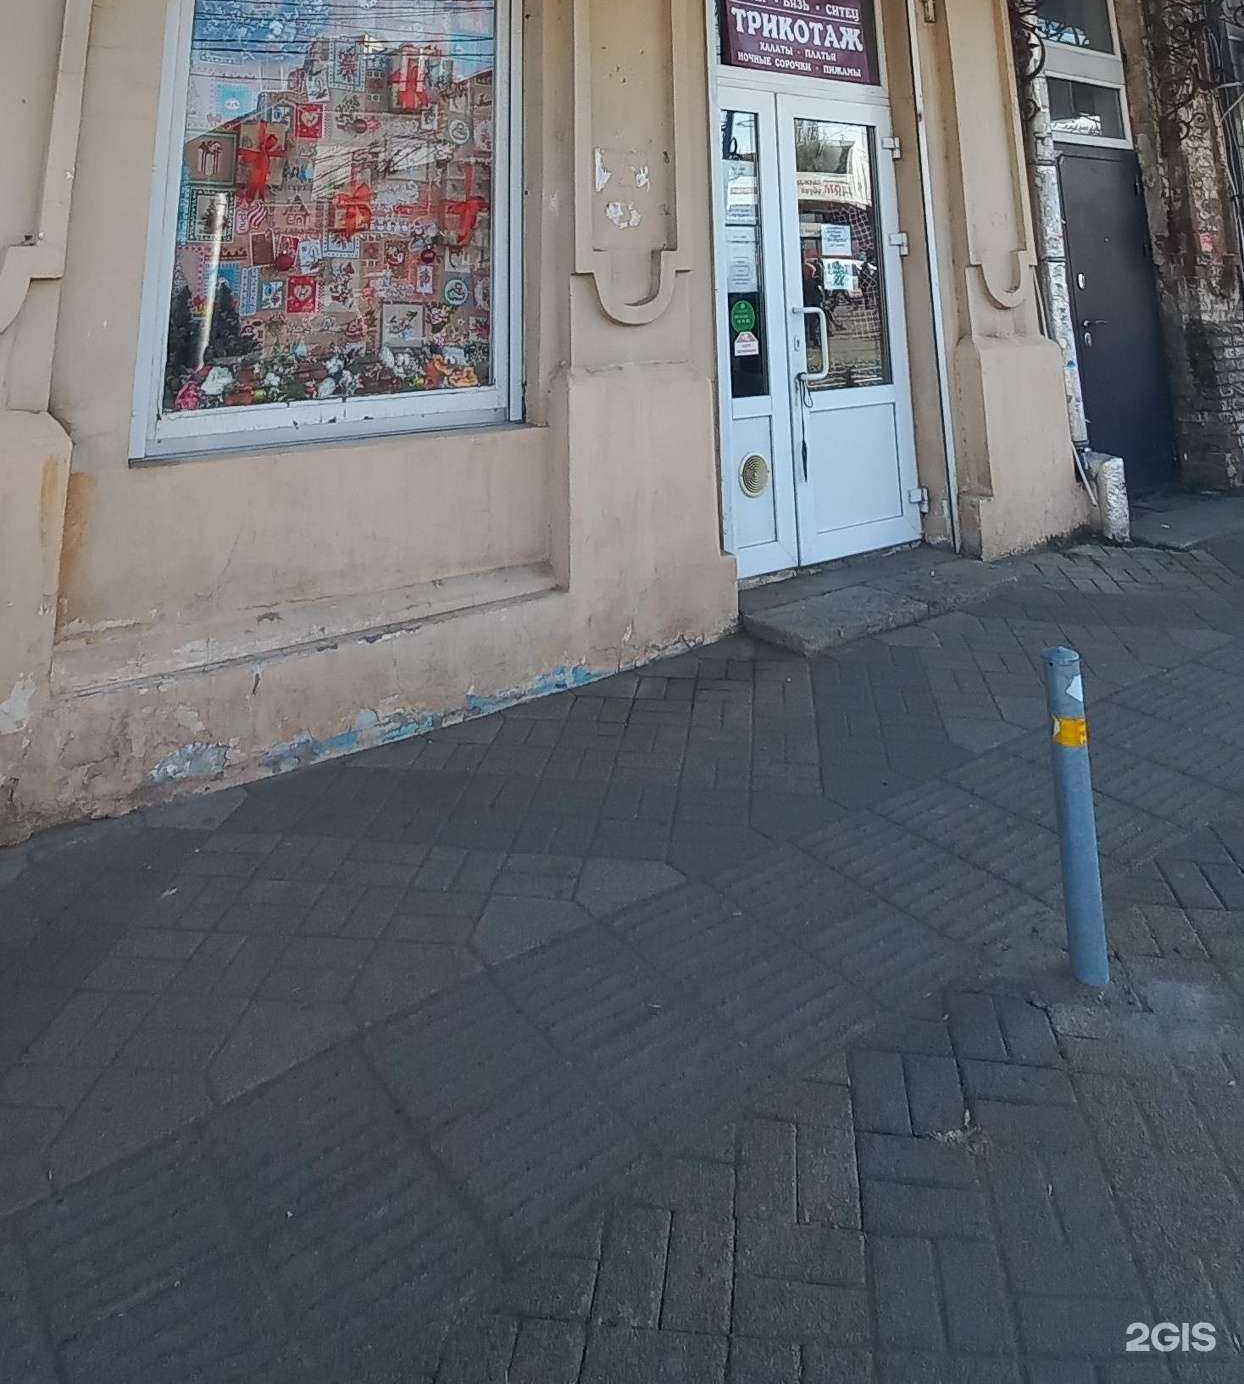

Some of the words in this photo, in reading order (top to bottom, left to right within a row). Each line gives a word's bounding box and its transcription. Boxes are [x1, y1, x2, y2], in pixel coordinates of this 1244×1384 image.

[825, 3, 860, 22] СИТЕЦ
[730, 7, 864, 52] ТРИКОТАЖ
[759, 41, 793, 56] ХАЛАТЫ
[804, 48, 837, 62] ПЛАТЬЯ
[737, 51, 772, 66] НОЧНЫЕ
[774, 57, 812, 72] СОРОЧКИ
[823, 64, 862, 78] ПИЖАМЫ
